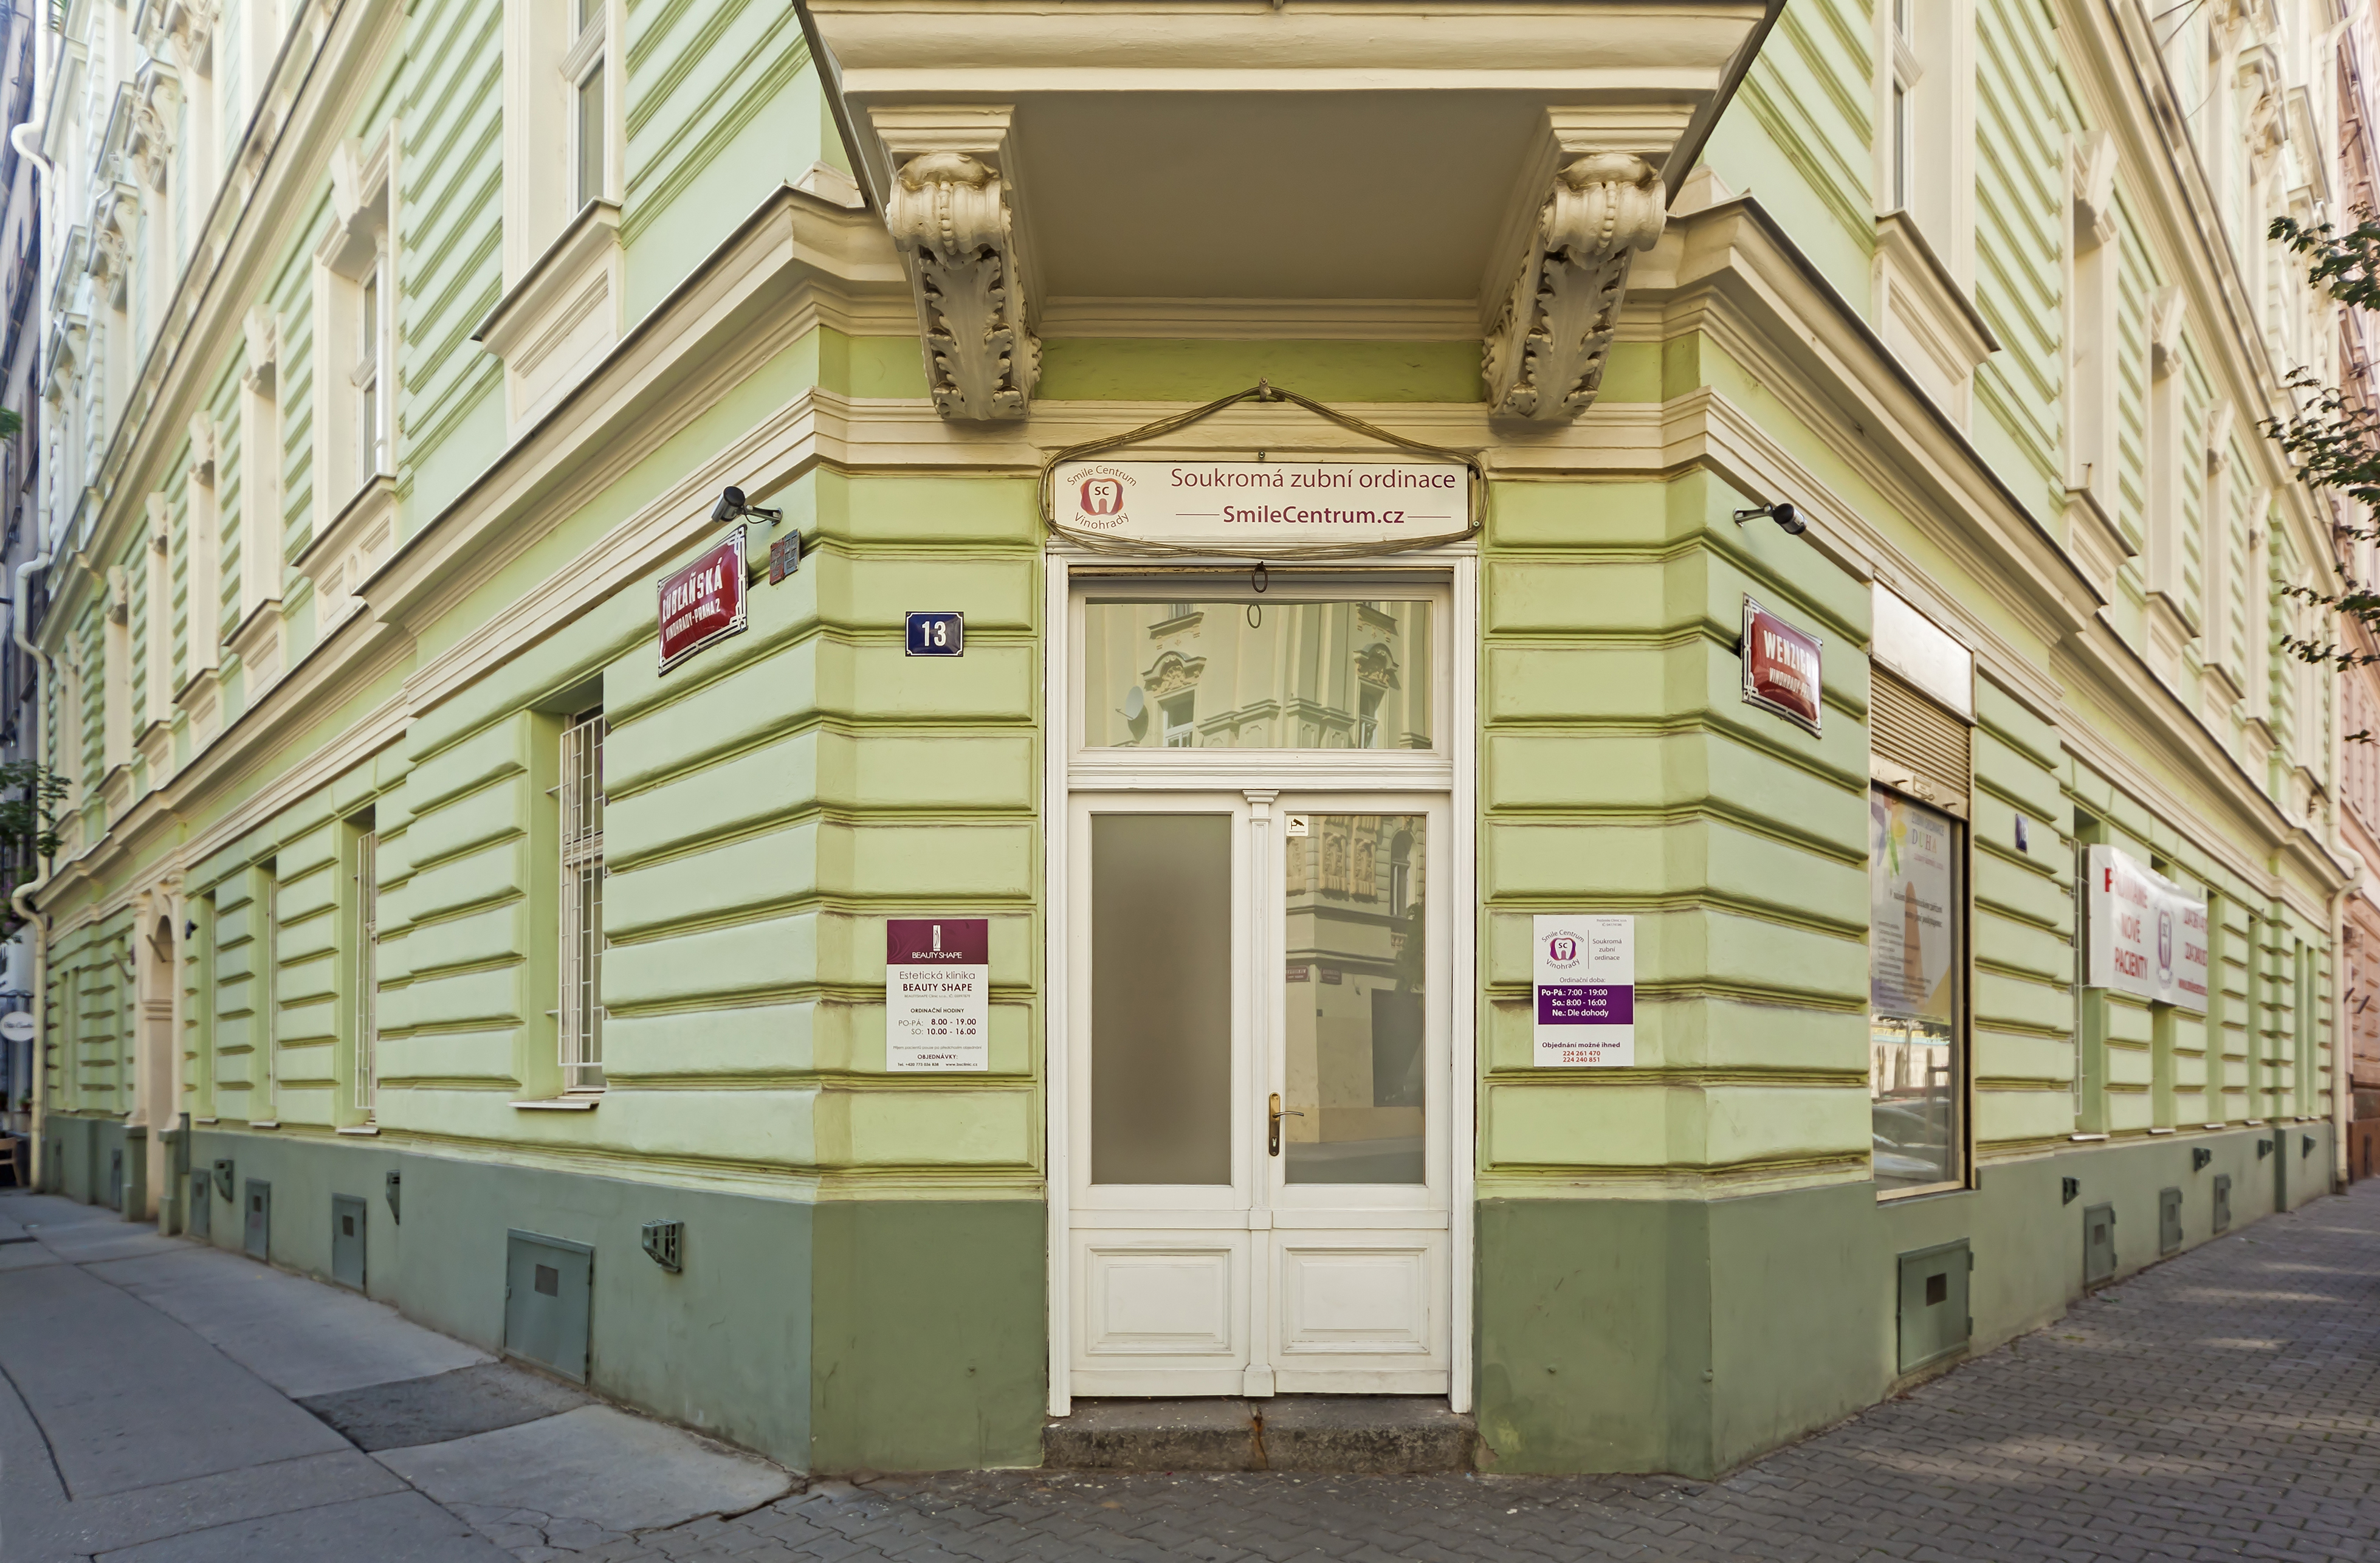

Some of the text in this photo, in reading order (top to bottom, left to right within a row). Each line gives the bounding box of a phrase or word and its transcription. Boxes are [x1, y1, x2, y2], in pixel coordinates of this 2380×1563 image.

[1067, 464, 1138, 488] Smile Centrum
[1171, 468, 1456, 488] Soukromá zubní ordinace
[1094, 486, 1110, 496] SC
[1074, 511, 1130, 530] Vinohrady
[1223, 505, 1405, 525] SmileCentrum.cz
[662, 557, 723, 624] LUBLAŇSKÁ
[922, 621, 946, 646] 13
[1764, 630, 1818, 683] WENZIGOV
[1912, 828, 1937, 854] DUHA
[1541, 929, 1584, 943] Smile Centrum
[1546, 958, 1580, 970] Vinohrady
[2114, 947, 2148, 980] PACIENTY
[899, 970, 975, 979] Estetická klinika
